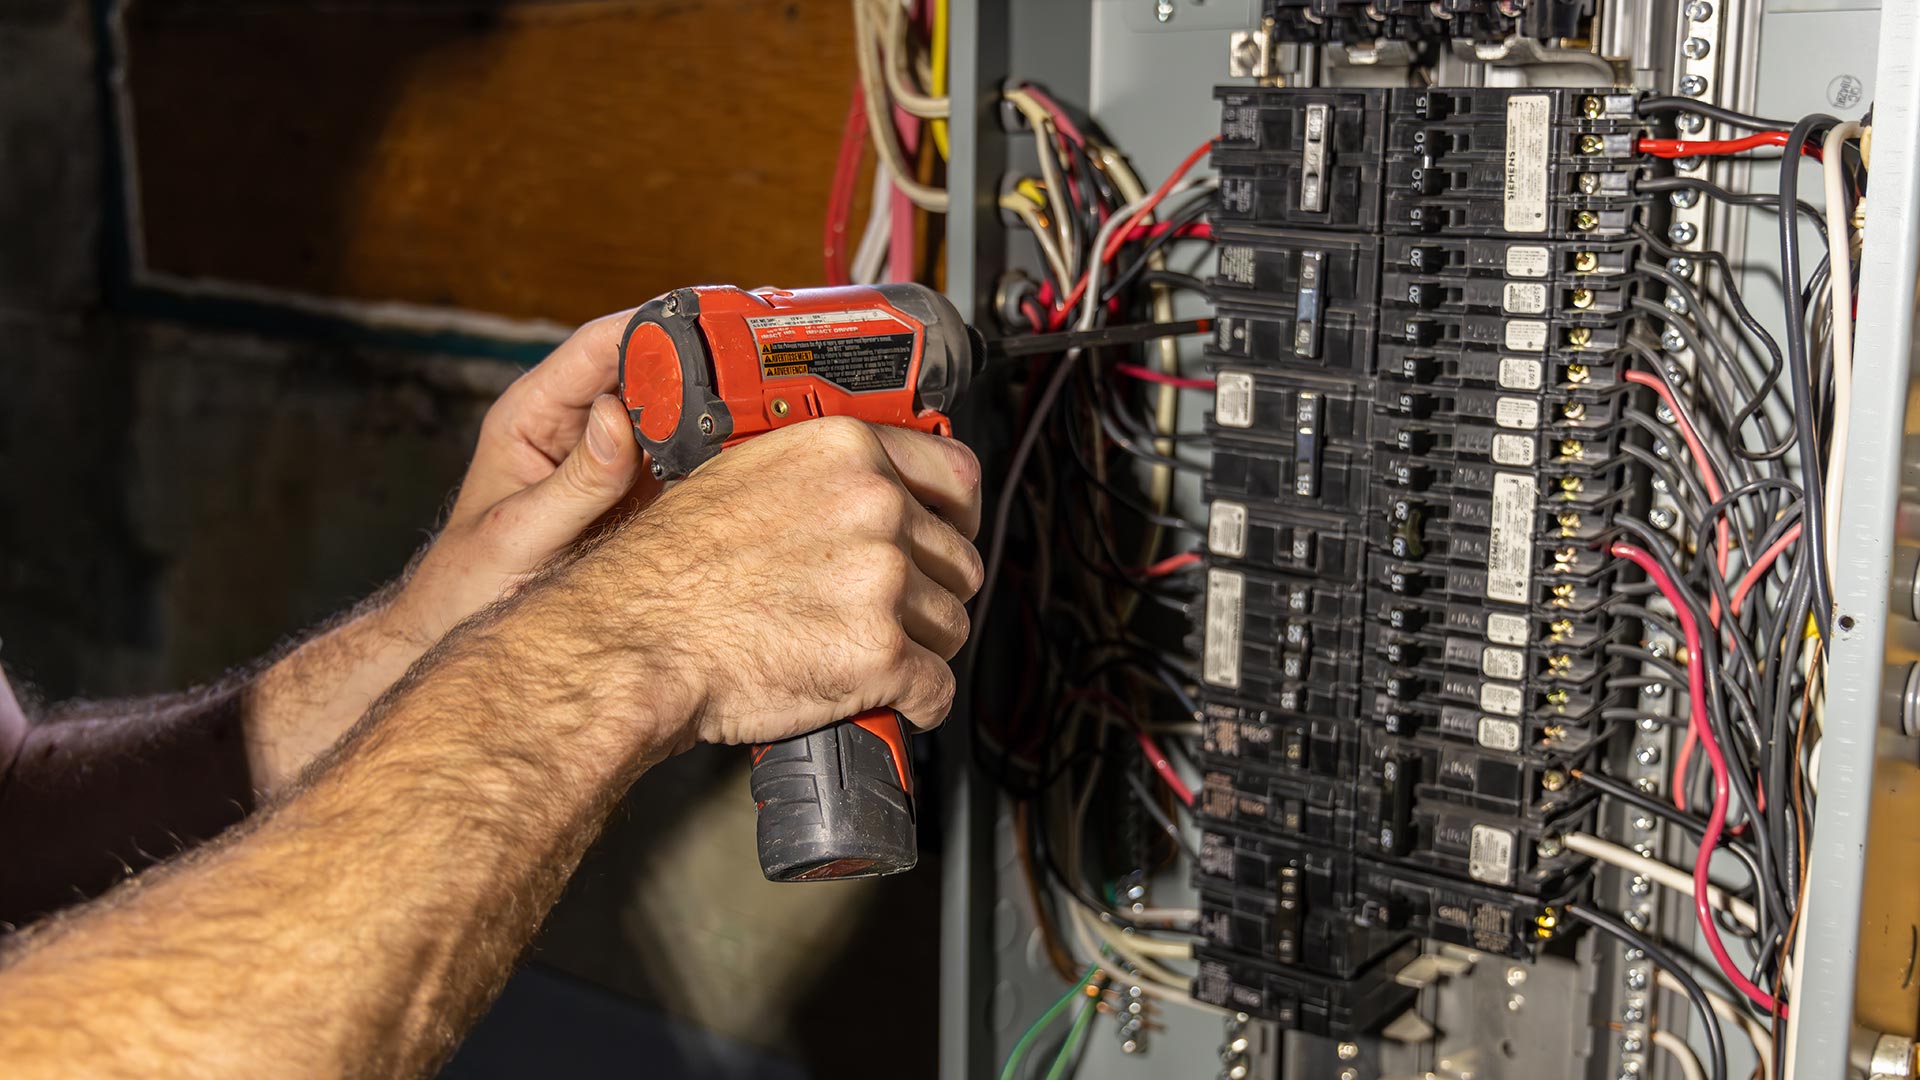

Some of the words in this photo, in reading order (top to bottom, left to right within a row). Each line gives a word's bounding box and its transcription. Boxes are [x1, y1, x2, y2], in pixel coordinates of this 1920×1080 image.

[1416, 97, 1427, 114] 15
[1414, 131, 1425, 154] 30
[1411, 169, 1422, 191] 30
[1508, 151, 1516, 200] SIEMENS
[1410, 208, 1421, 226] 15
[1411, 249, 1422, 267] 20
[1409, 286, 1420, 304] 20
[1406, 324, 1417, 341] 15
[772, 352, 811, 363] AVERTISSEMENT
[774, 366, 807, 376] ADVERTENCIA
[1404, 360, 1415, 378] 15
[1400, 395, 1412, 413] 15
[1300, 405, 1312, 422] 15
[1398, 432, 1411, 449] 15
[1297, 474, 1311, 496] 15
[1398, 467, 1410, 485] 15
[1395, 502, 1408, 520] 30
[1293, 541, 1306, 559] 20
[1393, 538, 1406, 557] 30
[1489, 527, 1501, 570] SIEMENS
[1391, 575, 1404, 592] 15
[1290, 591, 1305, 609] 15
[1391, 610, 1403, 627] 15
[1388, 644, 1400, 662] 15
[1387, 679, 1399, 697] 15
[1385, 714, 1399, 732] 15
